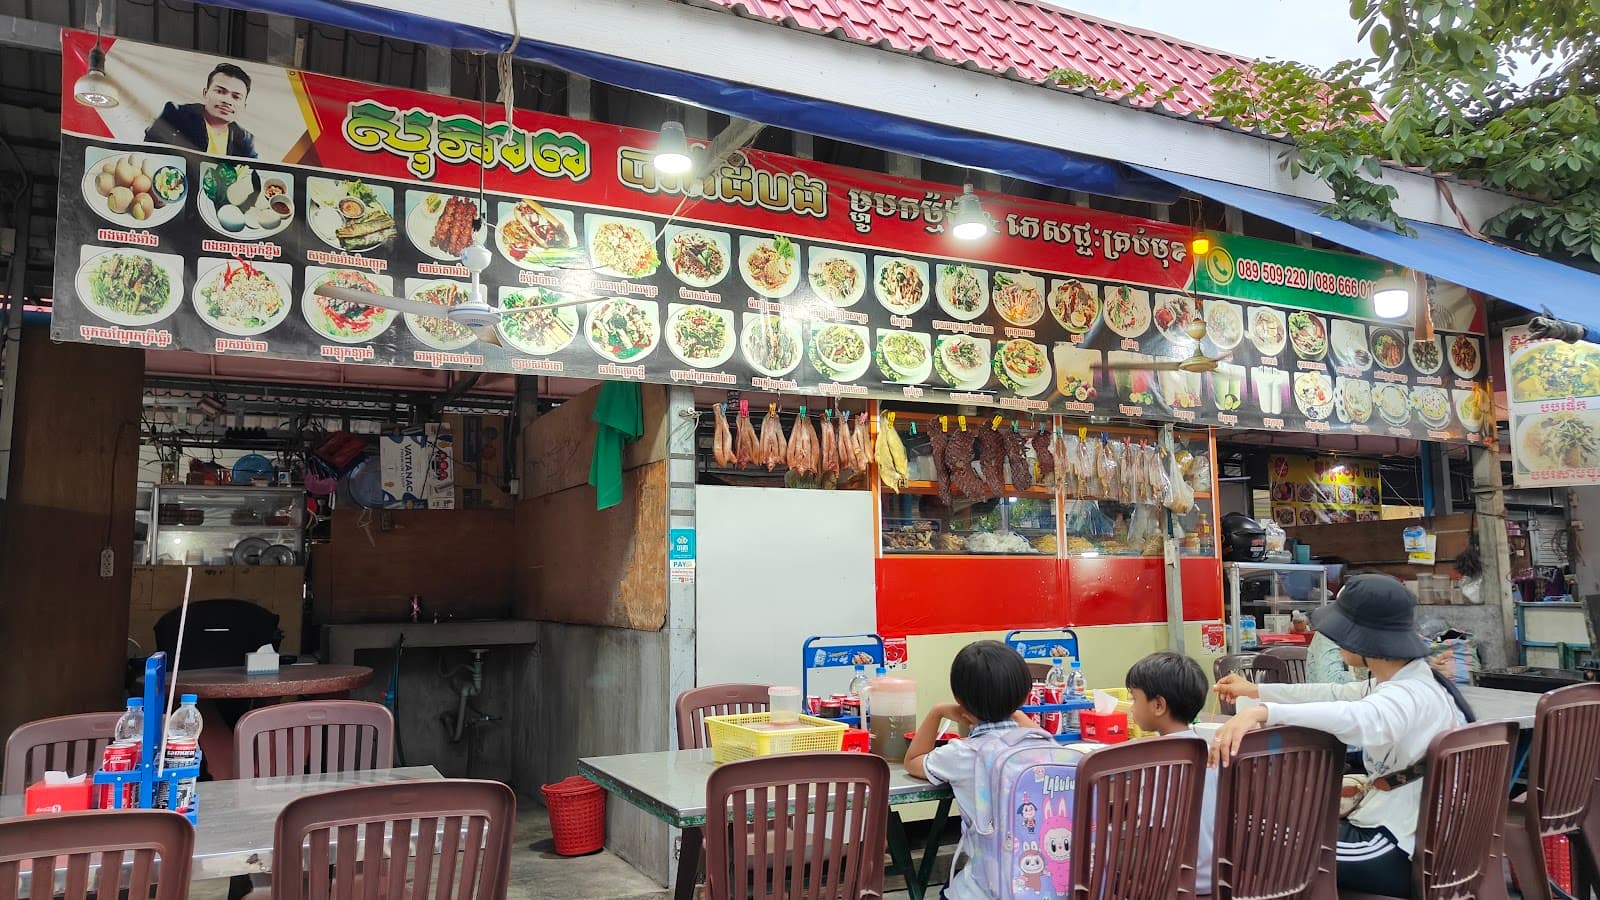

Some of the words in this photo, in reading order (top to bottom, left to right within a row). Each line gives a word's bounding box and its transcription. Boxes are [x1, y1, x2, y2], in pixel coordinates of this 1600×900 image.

[1237, 258, 1260, 279] 089
[1262, 262, 1284, 285] 509
[1286, 267, 1308, 289] 220
[1315, 272, 1336, 294] 088
[1338, 277, 1359, 298] 666
[404, 444, 414, 492] VATTANAC
